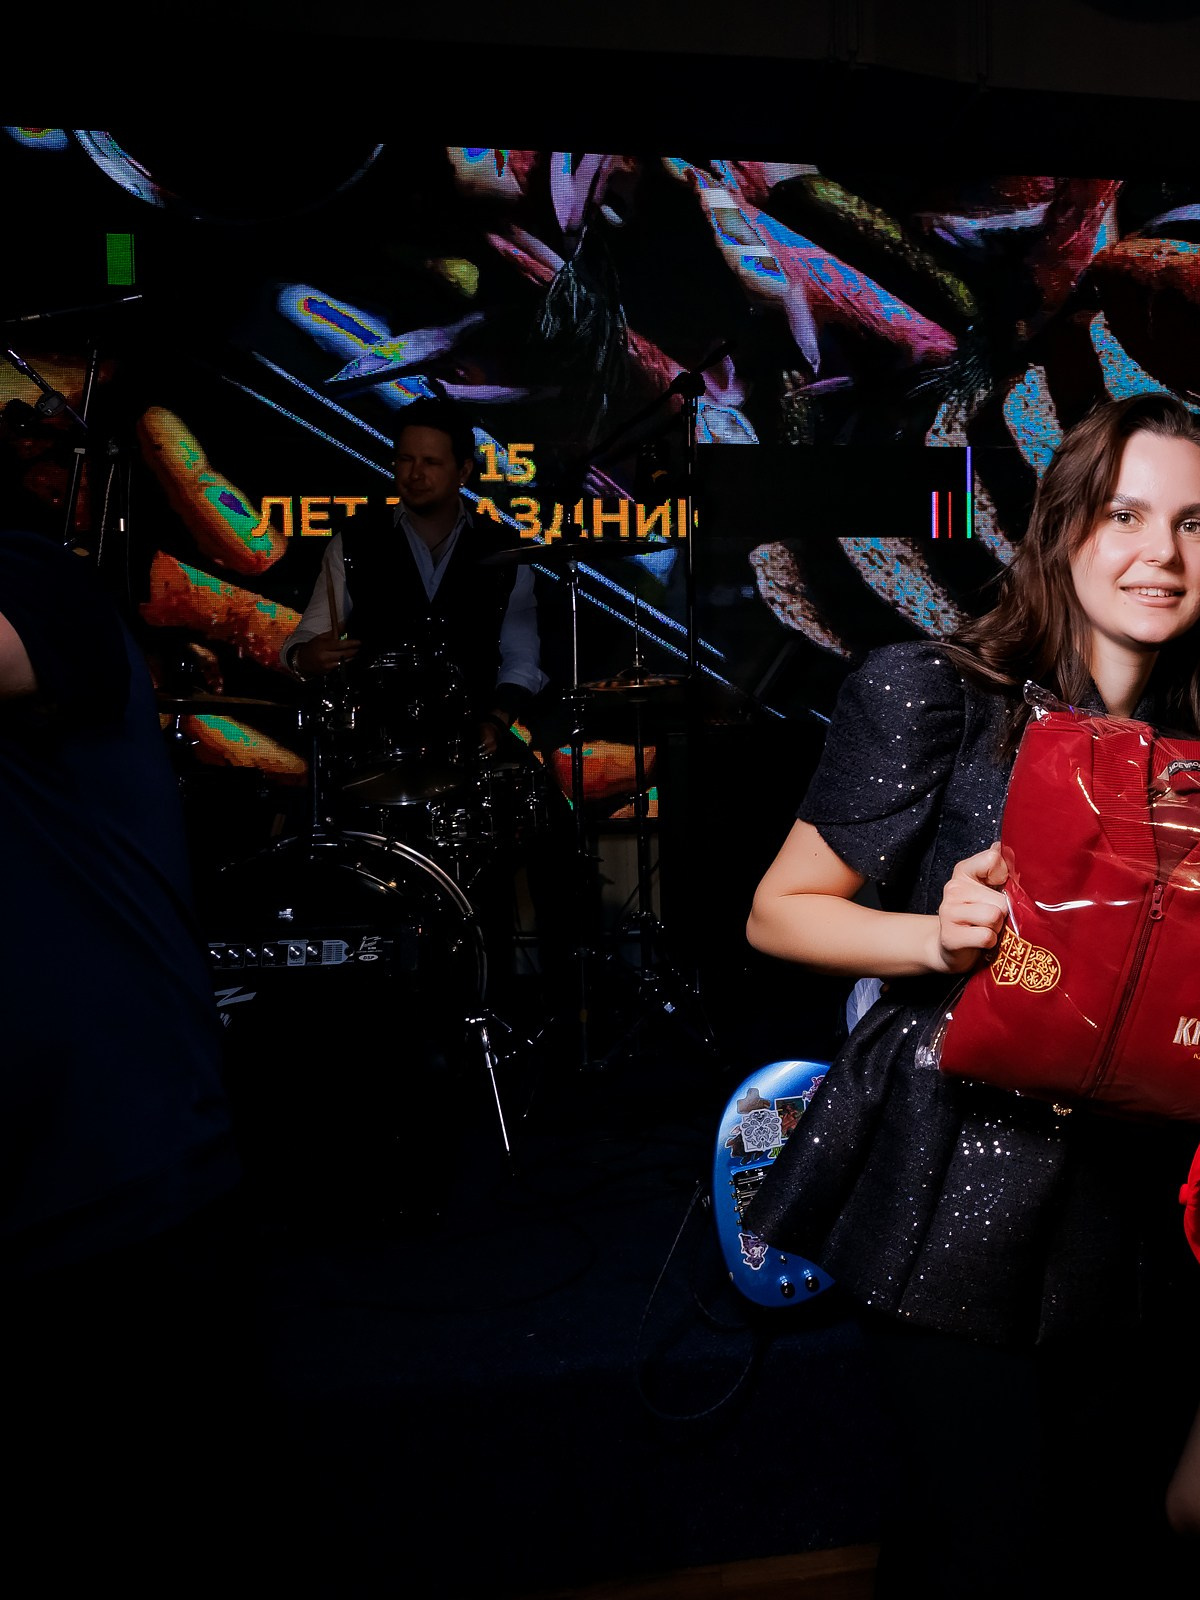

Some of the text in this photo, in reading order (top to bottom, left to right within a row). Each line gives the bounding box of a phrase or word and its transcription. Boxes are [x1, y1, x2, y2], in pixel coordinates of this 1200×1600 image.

[479, 443, 537, 483] 15
[250, 496, 699, 545] ЛЕТ ЗДНИ
